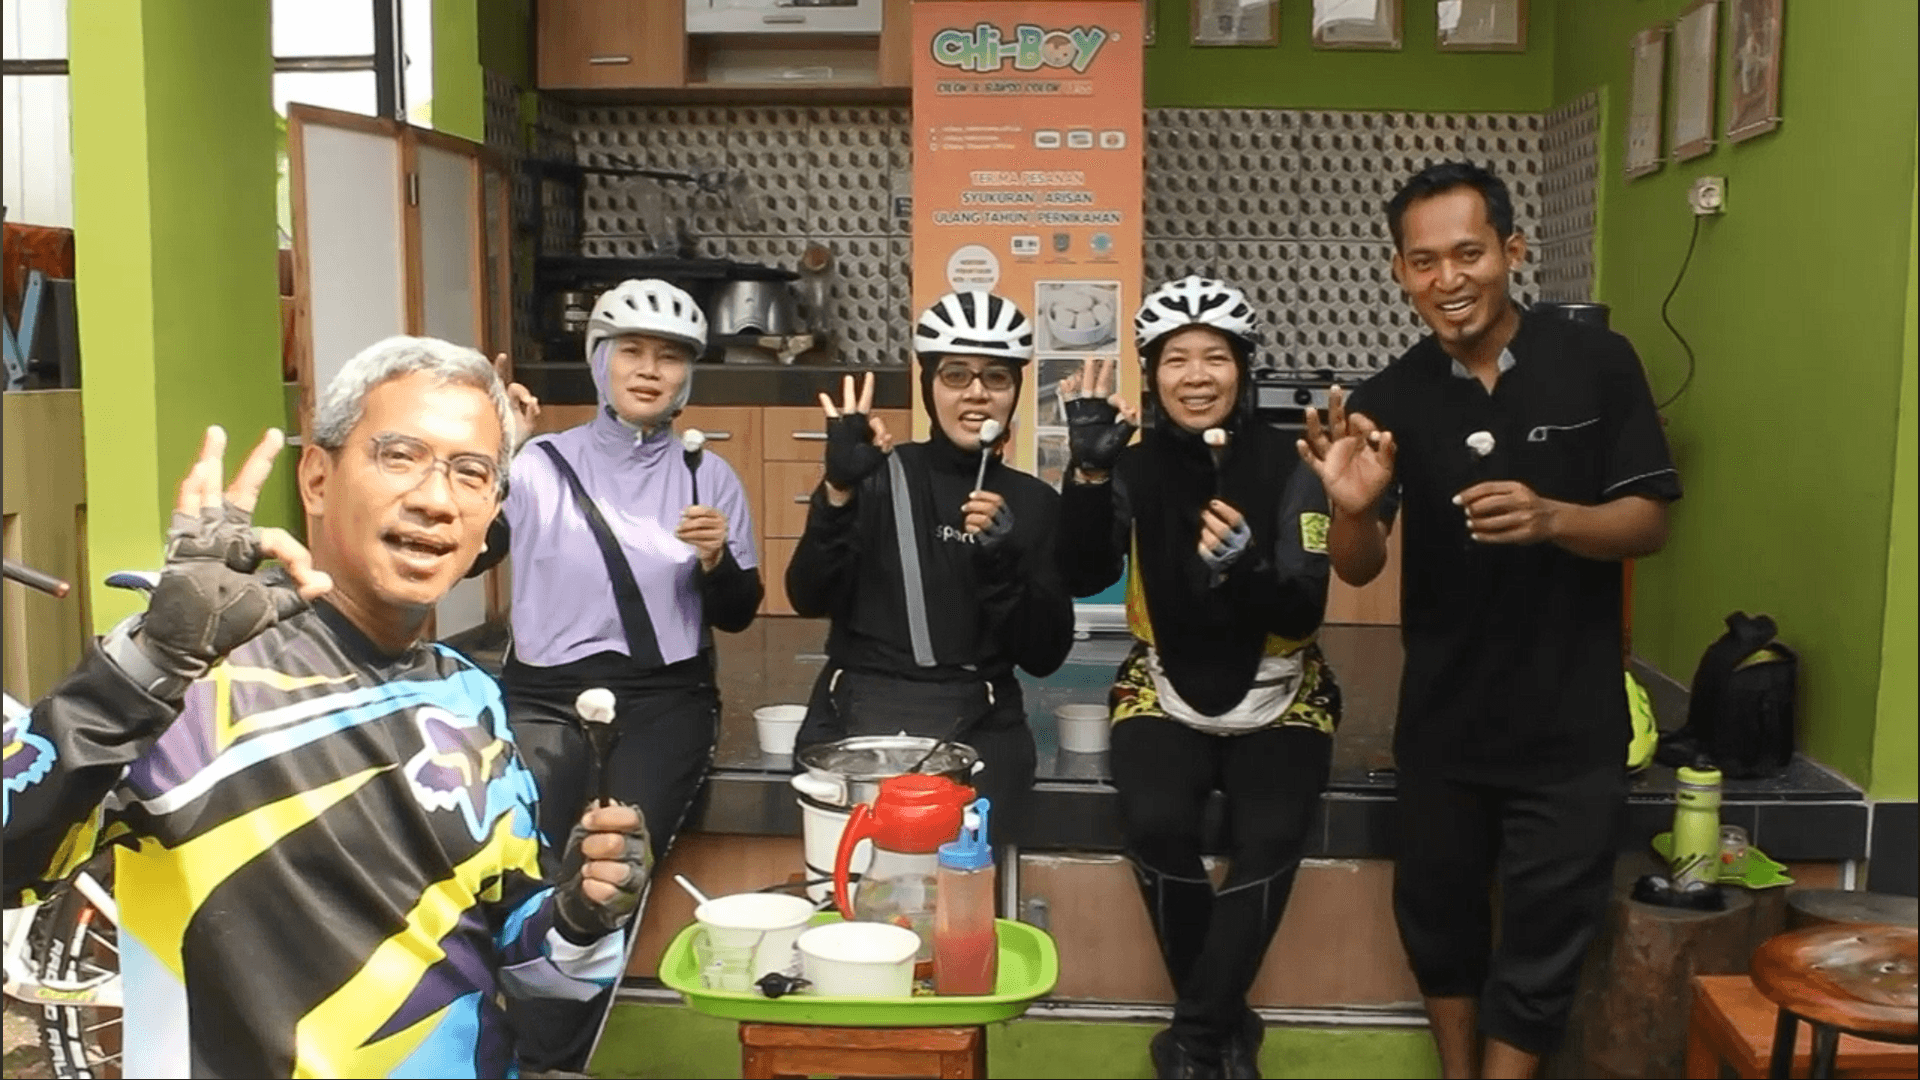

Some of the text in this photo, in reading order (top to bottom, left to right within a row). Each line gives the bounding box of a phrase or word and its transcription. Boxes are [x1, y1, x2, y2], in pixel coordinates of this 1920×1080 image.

[971, 172, 1084, 185] TERIMA PESANAN
[962, 191, 1093, 204] SYUKURAN ARISAN
[935, 211, 1120, 224] ULANG TAHUN PERNIKAHAN
